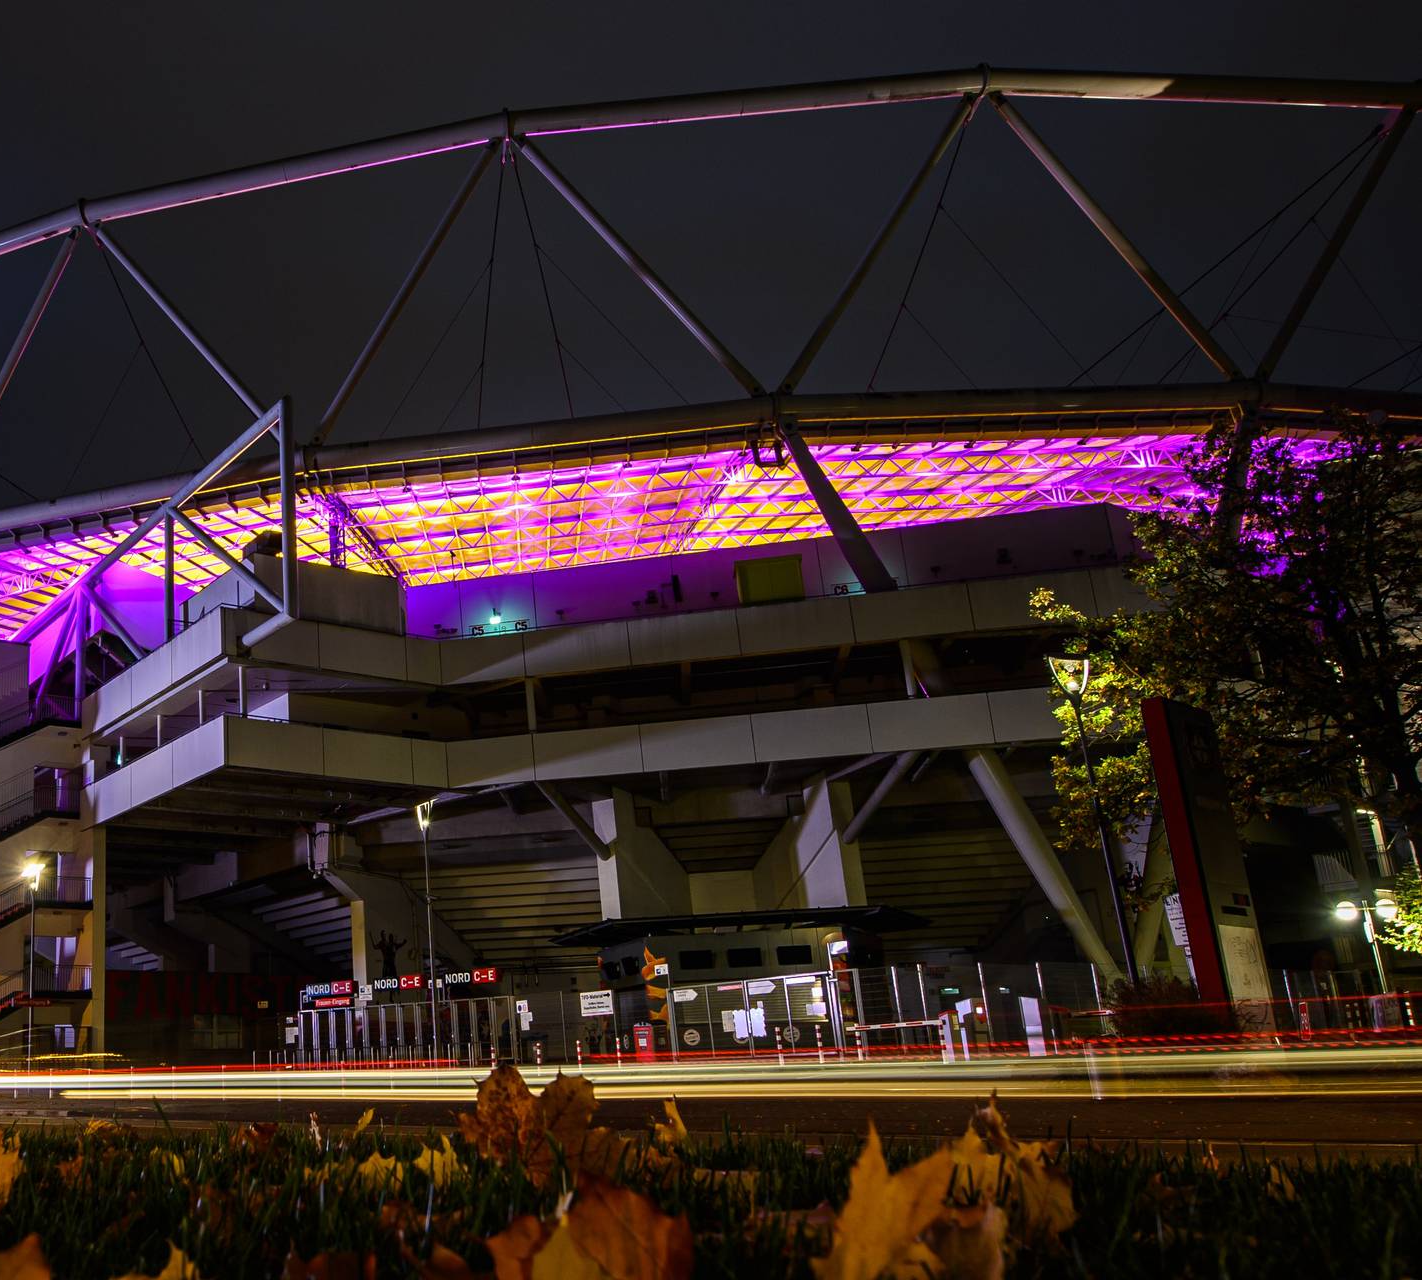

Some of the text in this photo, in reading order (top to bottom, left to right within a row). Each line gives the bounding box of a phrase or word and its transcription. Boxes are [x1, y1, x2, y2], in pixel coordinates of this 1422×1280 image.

[472, 626, 484, 636] C5
[515, 621, 528, 631] C5
[374, 976, 421, 990] NORD C-E
[445, 970, 495, 985] NORD C-E
[308, 982, 351, 996] NORD C-E
